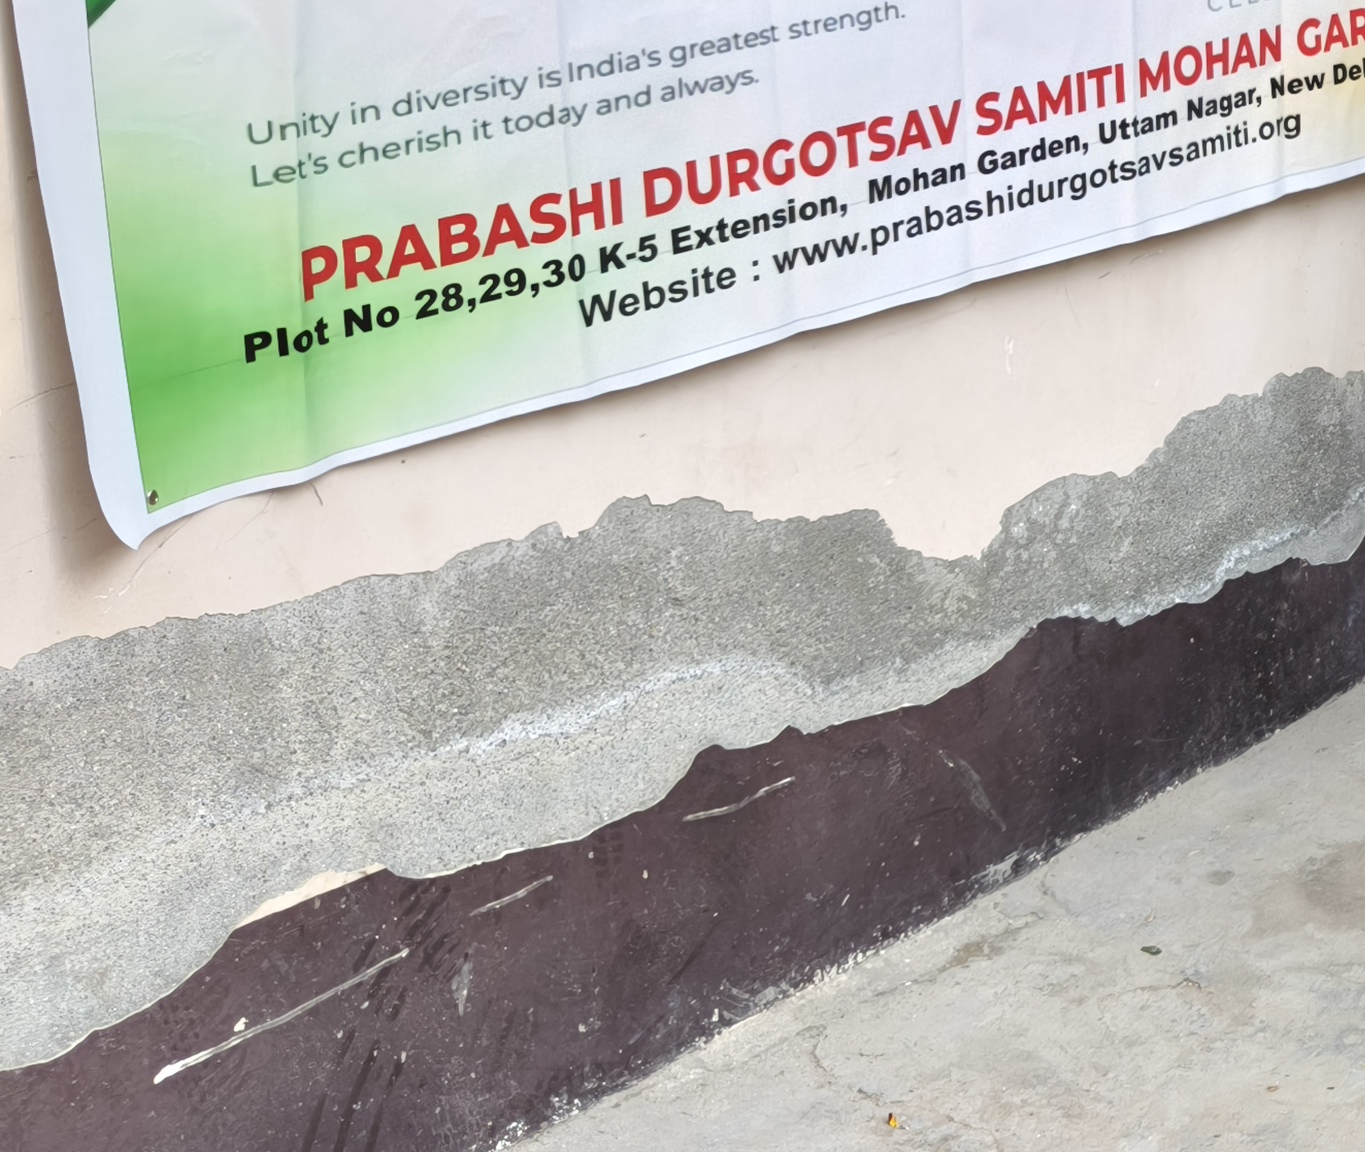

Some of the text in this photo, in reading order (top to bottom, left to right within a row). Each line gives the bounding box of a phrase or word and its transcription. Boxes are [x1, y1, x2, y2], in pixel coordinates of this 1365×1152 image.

[247, 0, 907, 147] Unity in diversity is India's greatest strength.
[251, 65, 760, 188] Let's cherish it today and always.
[301, 177, 625, 302] PRABASHI
[642, 99, 962, 219] DURGOTSAV
[974, 63, 1127, 136] SAMITI
[1138, 23, 1282, 99] MOHAN
[242, 316, 330, 364] Plot
[343, 302, 401, 339] No
[413, 251, 587, 322] 28,29,30
[598, 233, 659, 275] K-5
[670, 192, 849, 256] Extension,
[867, 160, 966, 205] Mohan
[976, 128, 1089, 177] Garden,
[1098, 110, 1178, 146] Uttam
[1186, 87, 1262, 121] Nagar,
[1270, 70, 1326, 101] New
[578, 265, 737, 328] Website
[772, 113, 1302, 277] www.prabashidurgotsavsamiti.org
